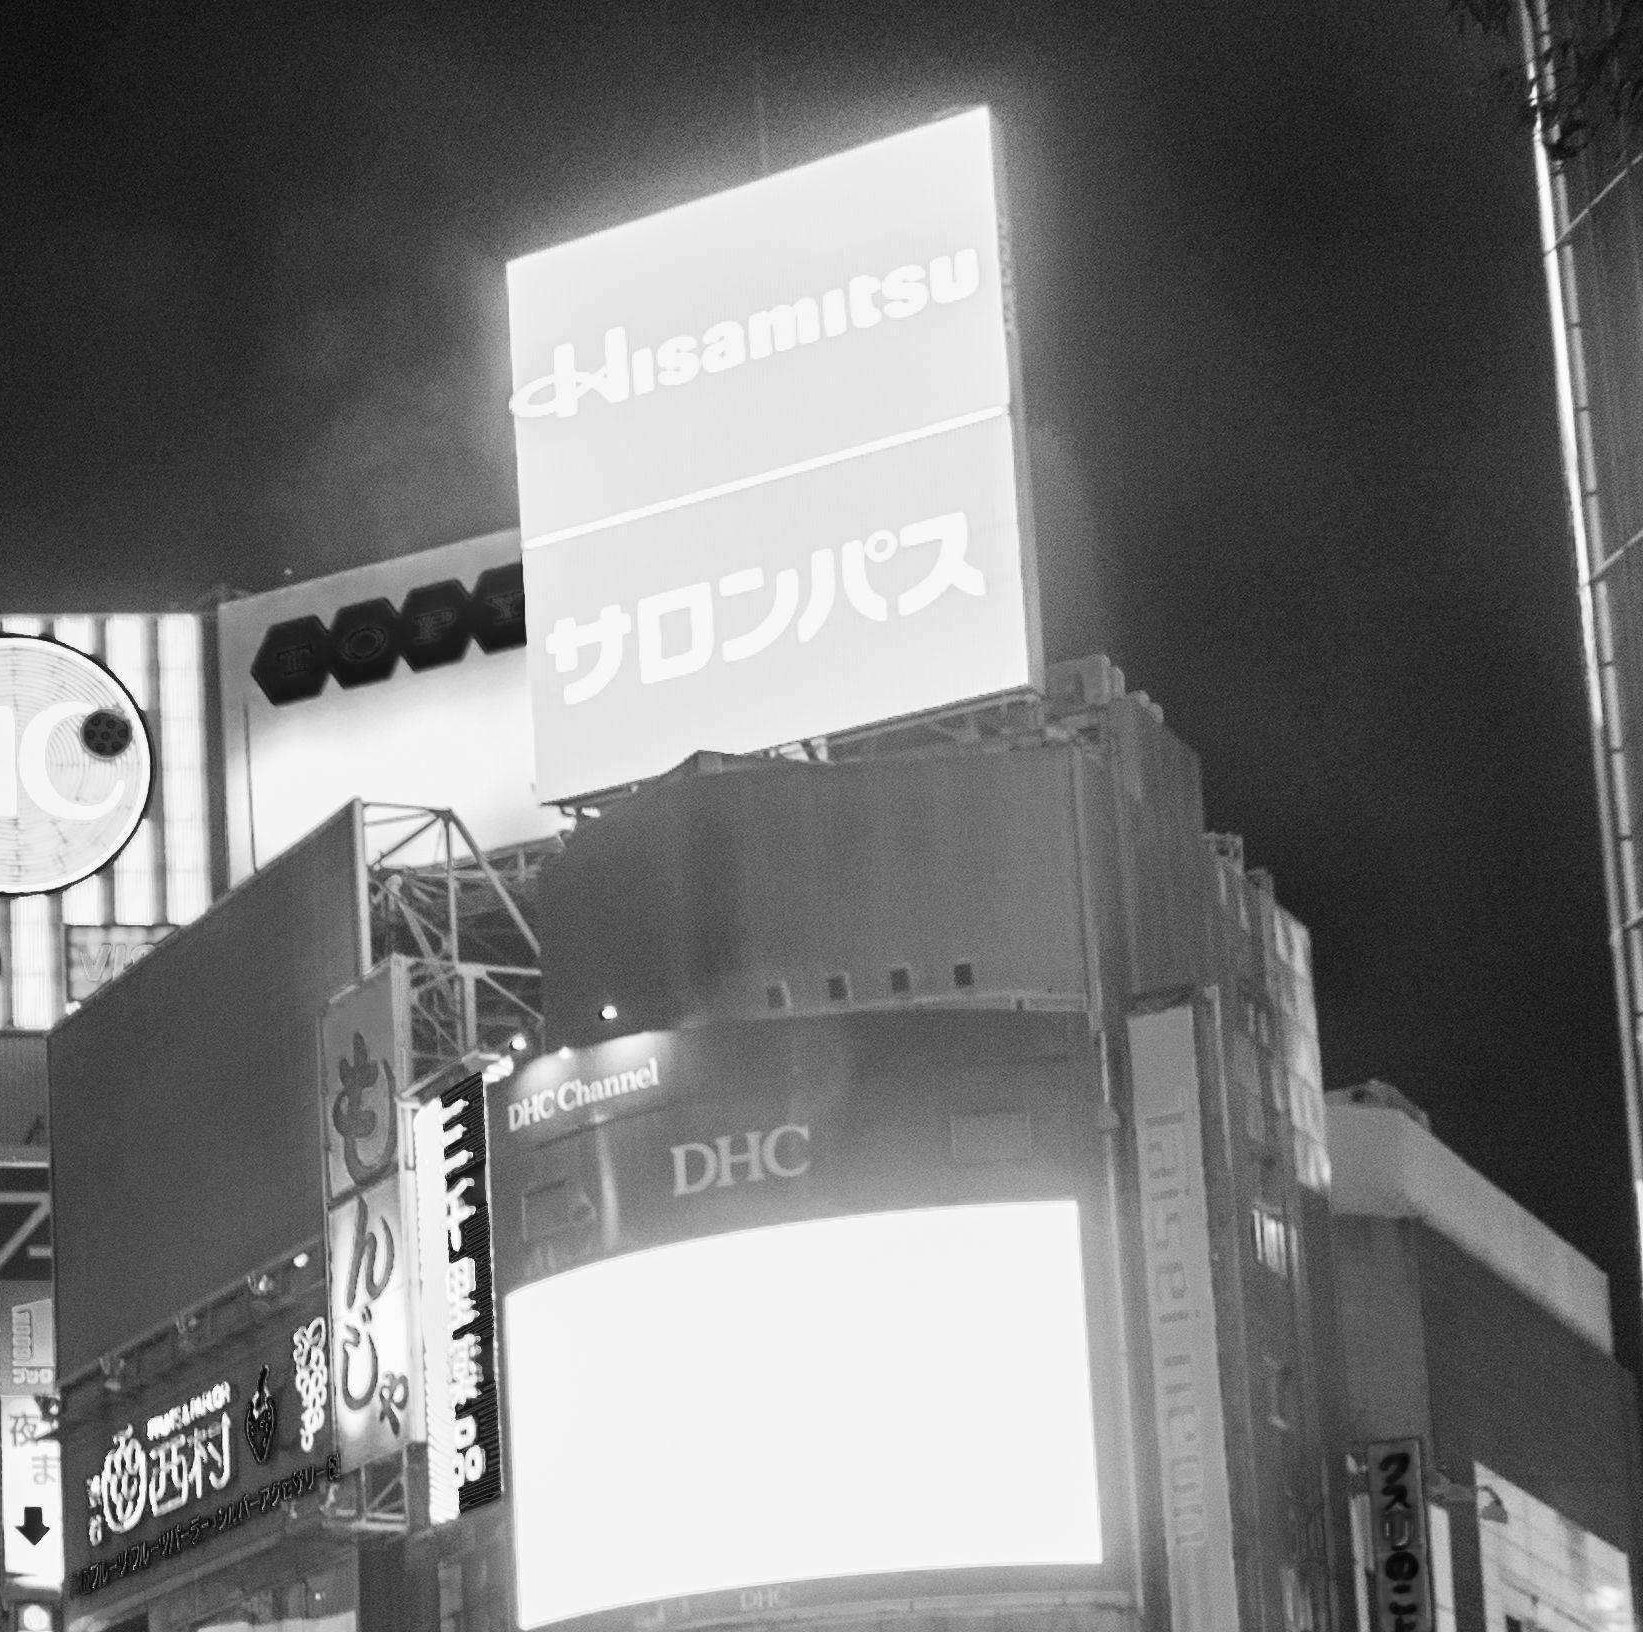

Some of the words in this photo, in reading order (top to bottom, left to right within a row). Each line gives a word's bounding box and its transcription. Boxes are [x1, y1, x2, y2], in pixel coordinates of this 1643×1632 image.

[509, 247, 979, 418] Hisamitsu
[545, 511, 987, 705] サロンパス
[508, 1095, 557, 1132] DHC
[557, 1059, 659, 1112] Channel
[671, 1123, 812, 1197] DHC
[148, 1411, 232, 1518] 西村
